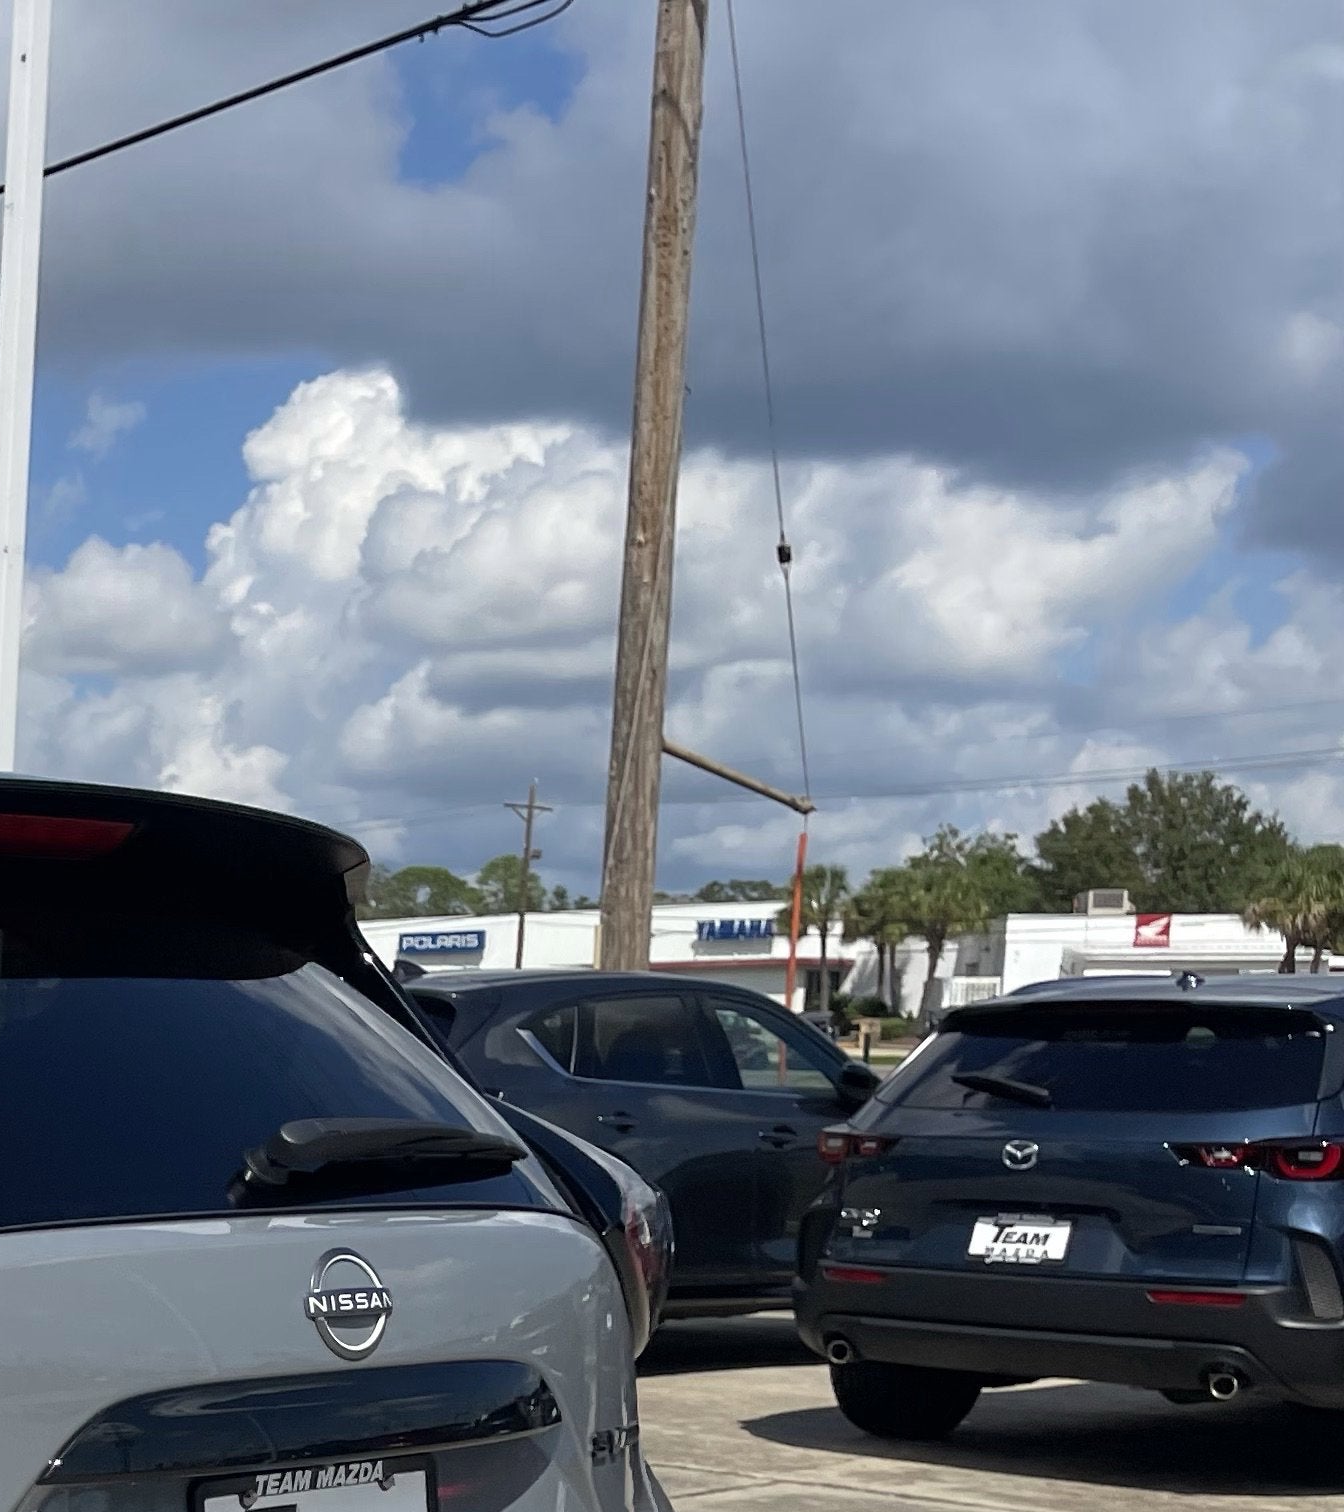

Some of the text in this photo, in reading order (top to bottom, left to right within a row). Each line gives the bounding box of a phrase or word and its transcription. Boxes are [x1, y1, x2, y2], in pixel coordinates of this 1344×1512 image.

[402, 934, 479, 950] POLARIS
[308, 1292, 392, 1313] NISSAN
[256, 1461, 383, 1496] TEAM MAZDA
